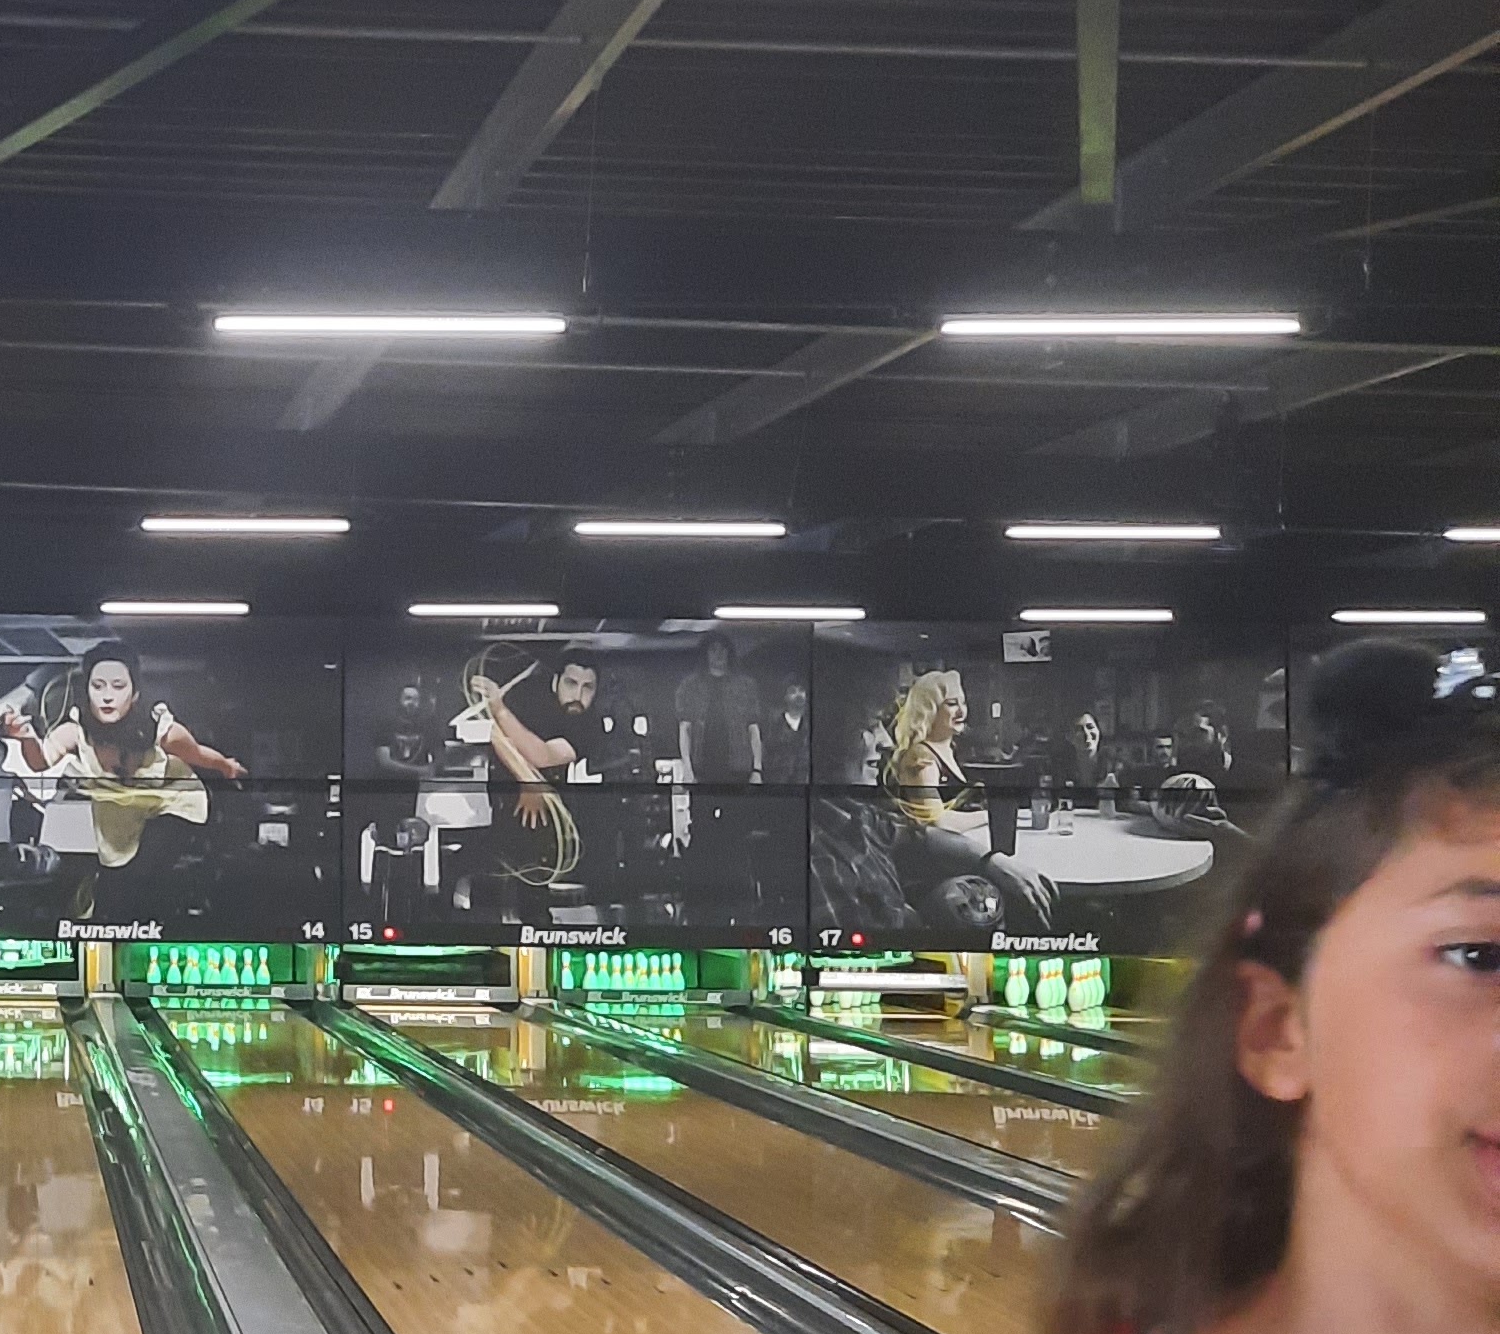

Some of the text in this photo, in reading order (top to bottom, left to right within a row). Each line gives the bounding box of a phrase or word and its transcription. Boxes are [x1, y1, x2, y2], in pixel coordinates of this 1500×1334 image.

[58, 920, 163, 940] Brunswick
[302, 922, 325, 940] 14
[349, 922, 793, 946] 15 Brunswick 16
[818, 929, 1100, 952] 17 Brunswick
